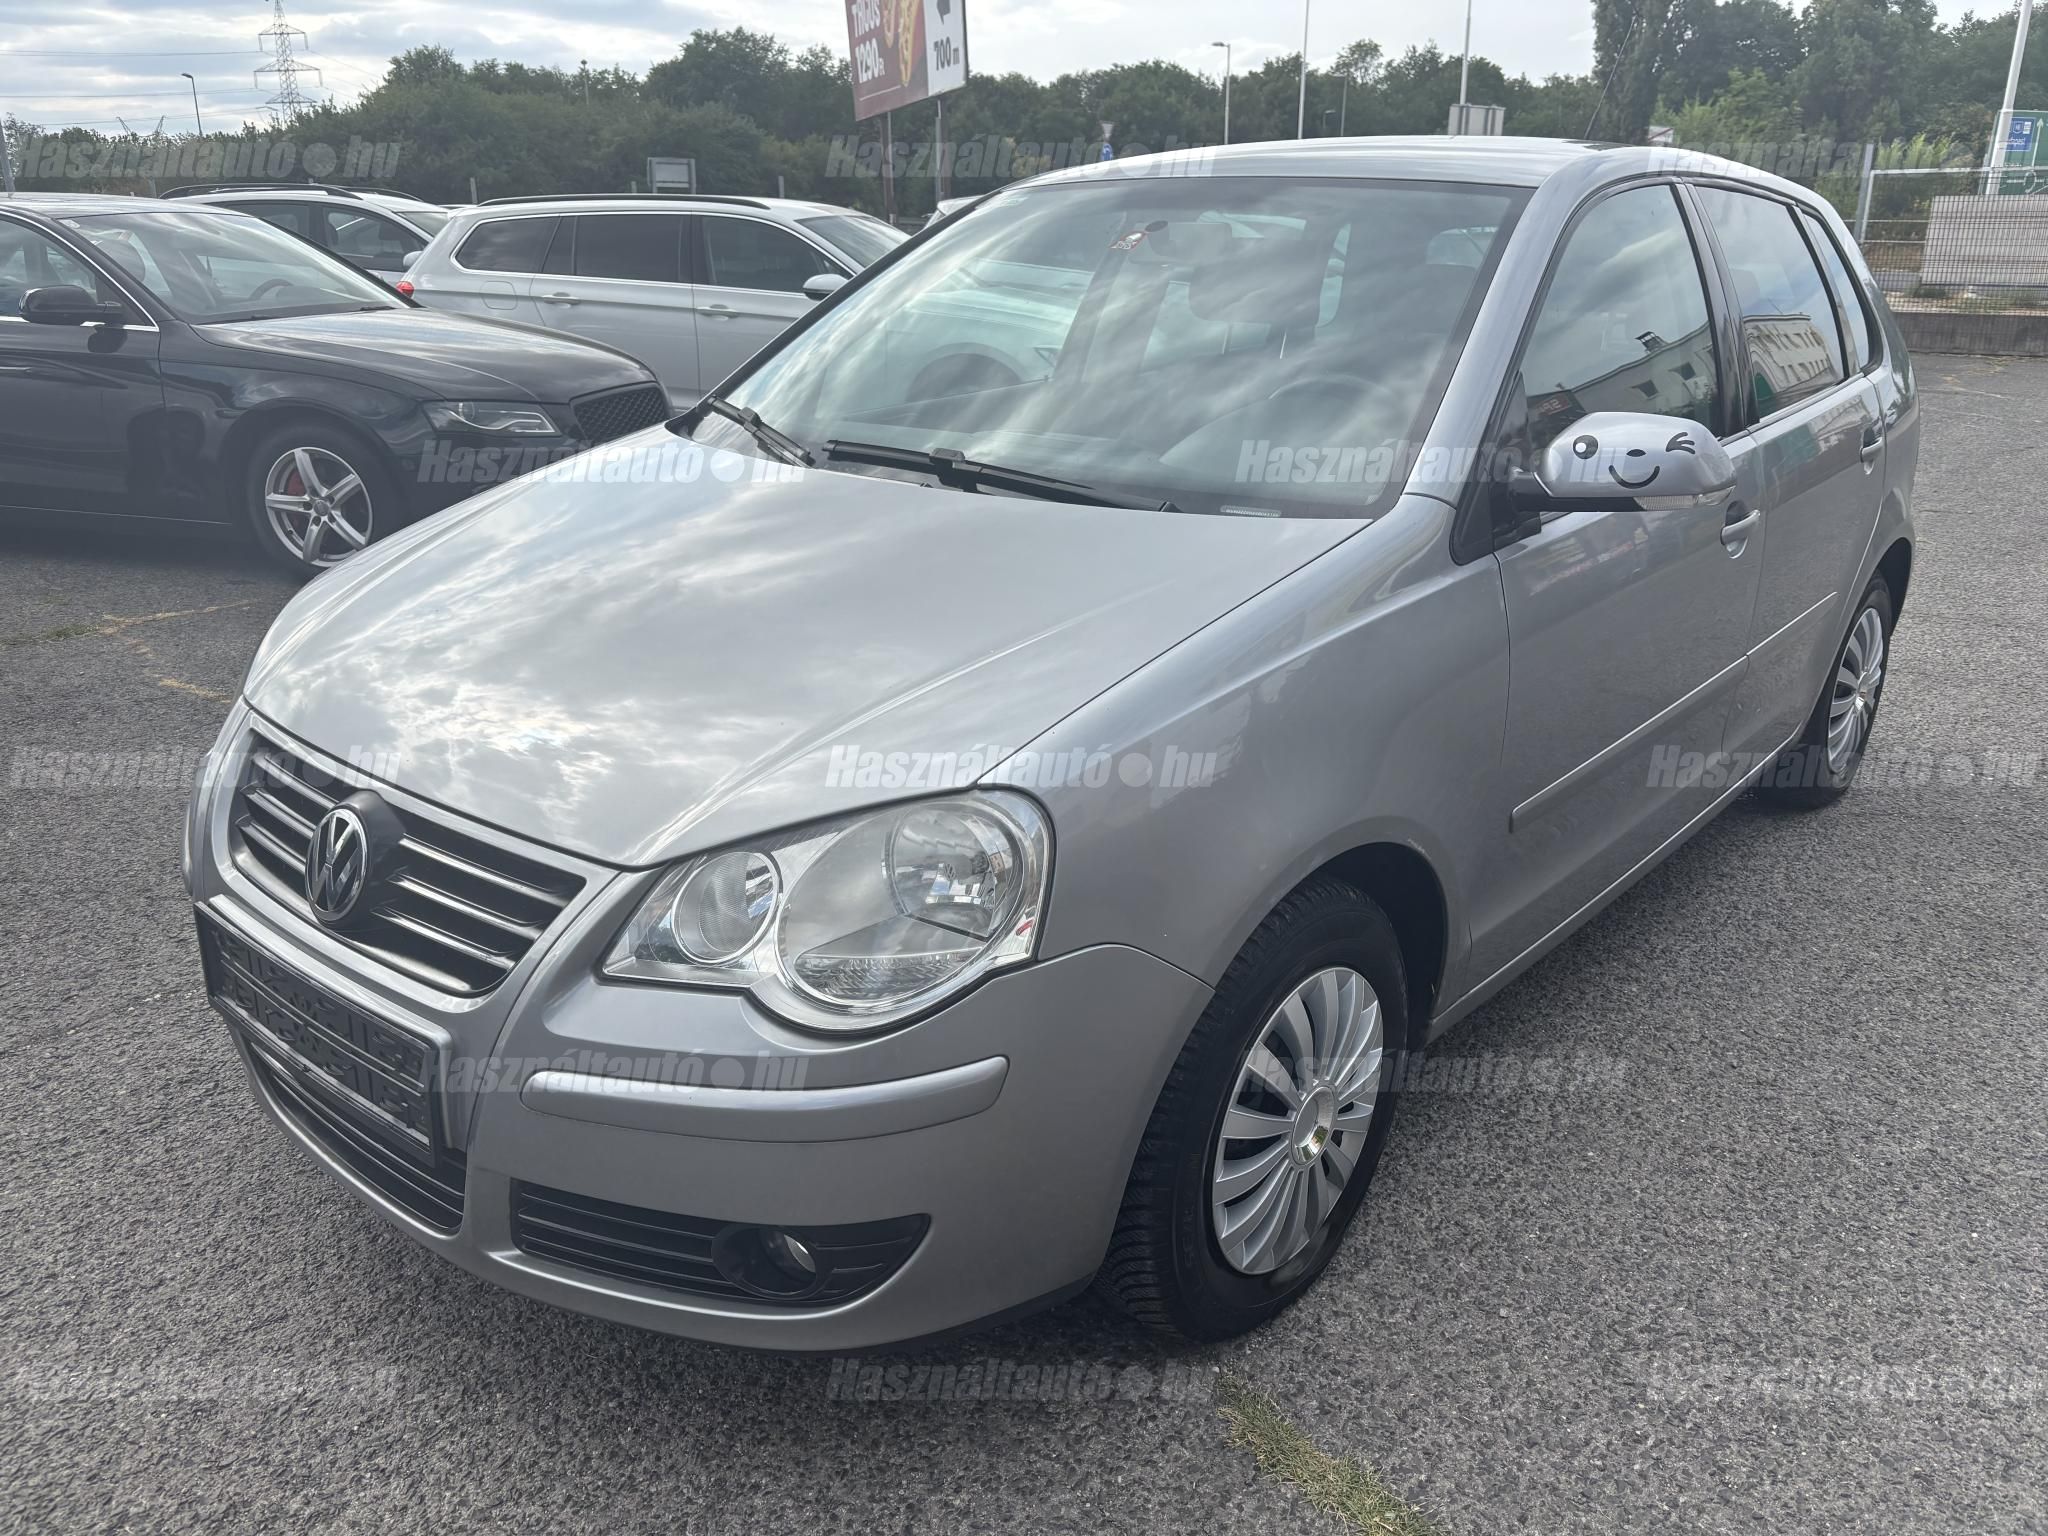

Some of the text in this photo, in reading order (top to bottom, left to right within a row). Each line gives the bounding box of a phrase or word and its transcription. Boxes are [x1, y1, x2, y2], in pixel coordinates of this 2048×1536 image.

[855, 38, 879, 84] 1290
[934, 36, 960, 71] 700 m
